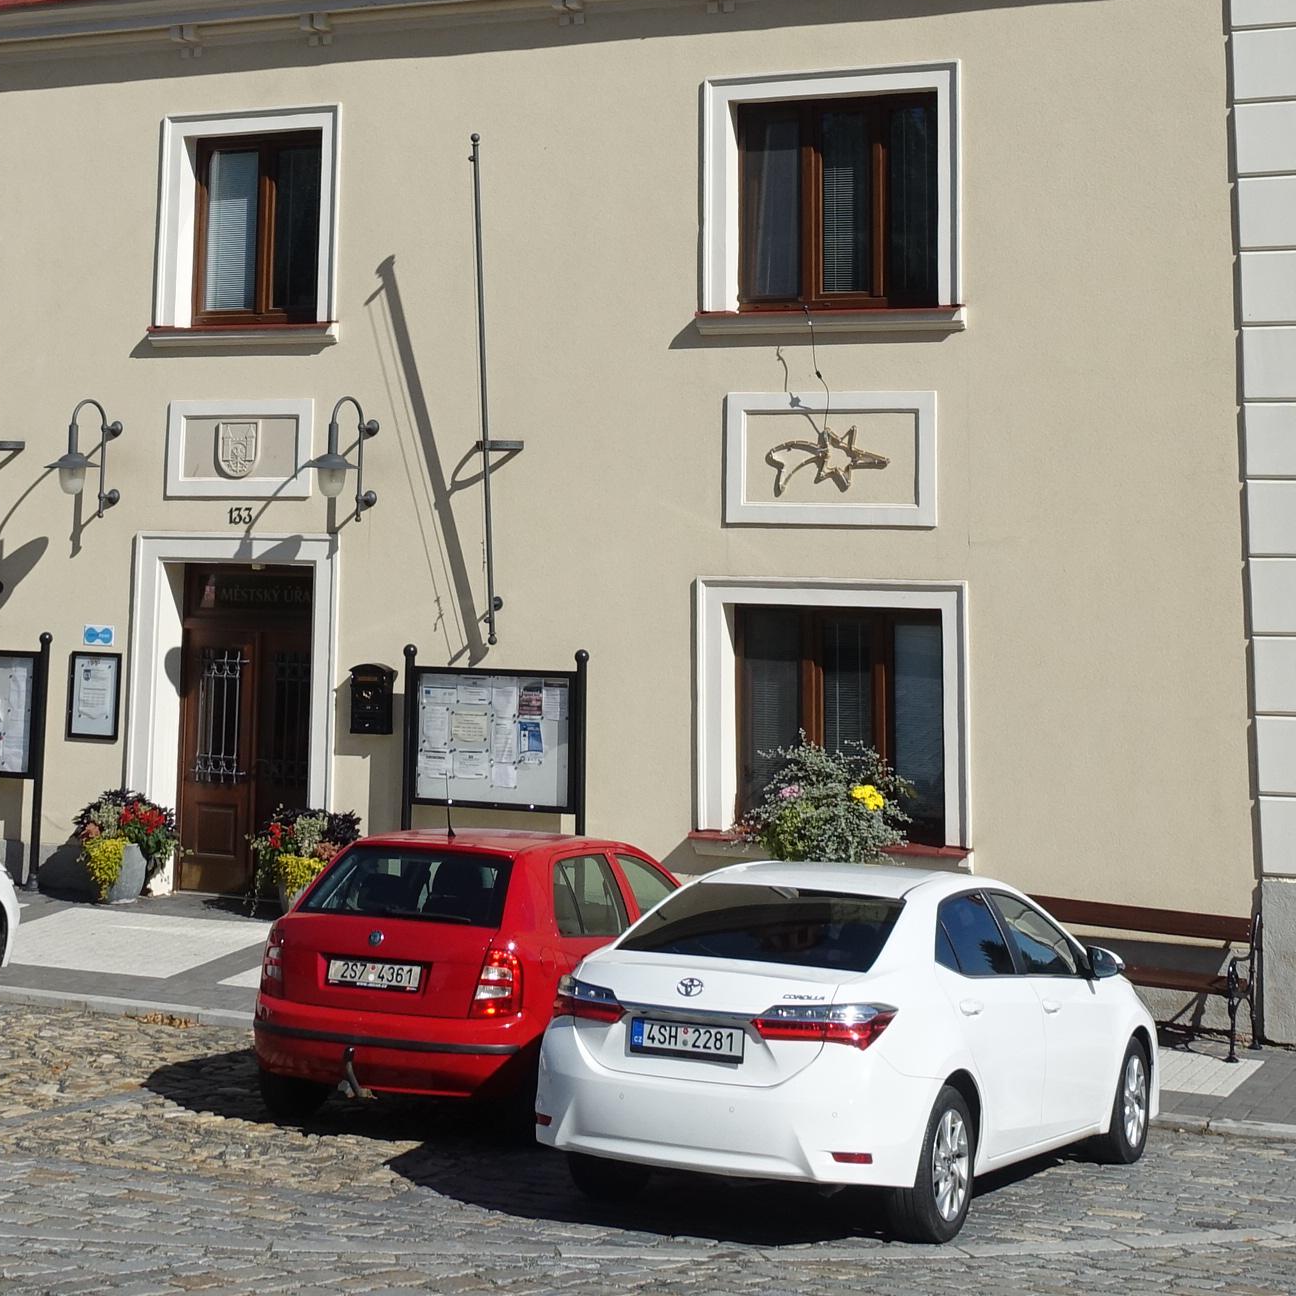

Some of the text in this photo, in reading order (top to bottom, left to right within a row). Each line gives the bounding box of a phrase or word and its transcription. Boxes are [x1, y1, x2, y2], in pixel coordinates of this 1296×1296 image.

[227, 507, 253, 525] 133
[219, 585, 312, 603] MĚSTSKÝ ÚŘA
[340, 962, 367, 980] 2S7
[377, 966, 413, 985] 4361
[646, 1024, 678, 1047] 4SH
[691, 1030, 735, 1052] 2281
